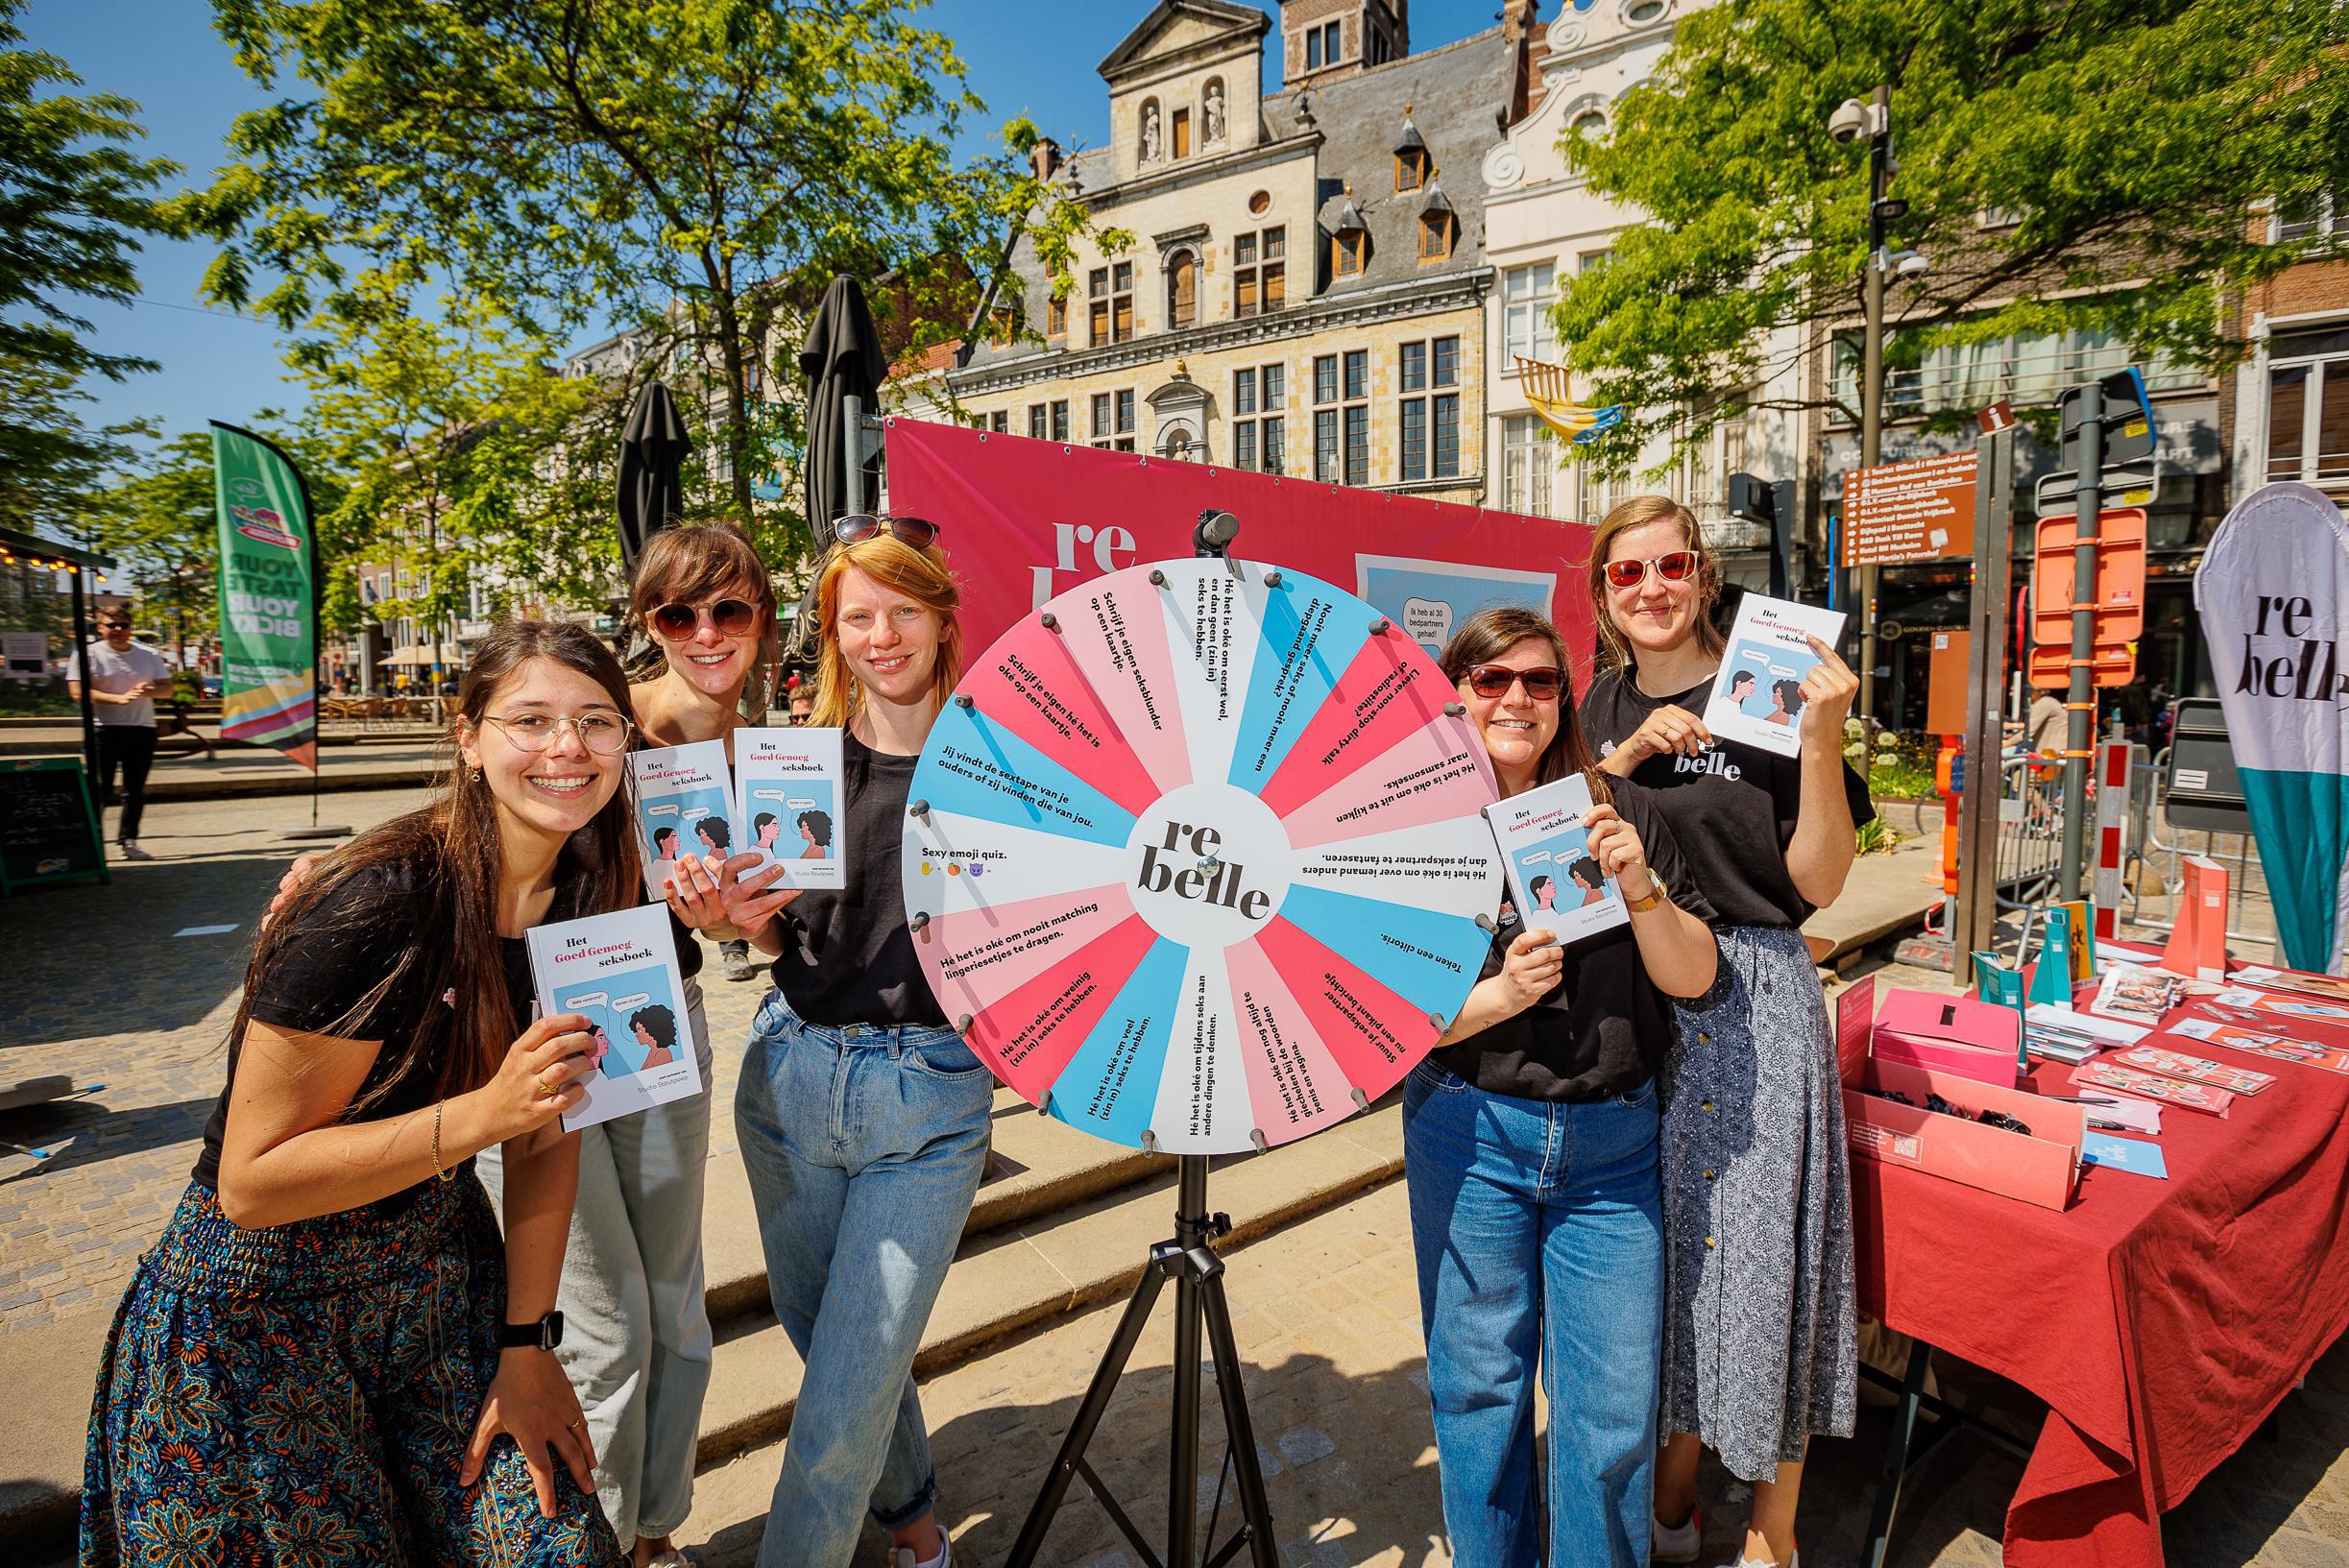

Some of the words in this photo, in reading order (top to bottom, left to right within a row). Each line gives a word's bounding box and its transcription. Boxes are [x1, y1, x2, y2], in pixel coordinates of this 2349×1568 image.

[1053, 522, 1136, 573] re
[1314, 603, 1333, 633] Nooit
[1417, 608, 1428, 616] heb
[1436, 609, 1443, 617] 30
[1750, 616, 1773, 627] Goed
[1762, 609, 1778, 618] Het
[2254, 595, 2313, 638] re
[1292, 597, 1320, 651] diepgaand
[1409, 618, 1444, 628] bedpartners
[1091, 597, 1101, 612] op
[1097, 613, 1109, 632] een
[1104, 632, 1125, 673] kaartje.
[1417, 630, 1437, 639] gehad!
[1303, 633, 1319, 661] meer
[1102, 591, 1125, 626] Schrijf
[1114, 626, 1126, 639] je
[1122, 639, 1137, 668] eigen
[1132, 668, 1162, 731] seksblunder
[1397, 662, 1408, 675] of
[1273, 650, 1296, 698] gesprek?
[1292, 660, 1306, 685] seks
[1393, 668, 1420, 694] Liever
[1007, 654, 1038, 683] Schrijf
[1031, 680, 1044, 692] je
[1043, 691, 1067, 715] eigen
[1065, 711, 1078, 726] hé
[1077, 722, 1093, 740] het
[1090, 736, 1101, 748] is
[1287, 685, 1296, 698] of
[1354, 670, 1399, 717] radiostilte?
[998, 665, 1016, 682] oké
[1014, 681, 1027, 693] op
[1026, 692, 1042, 709] een
[1040, 705, 1071, 740] kaartje.
[1274, 697, 1291, 725] nooit
[1358, 692, 1394, 729] non-stop
[761, 742, 776, 752] Het
[1264, 726, 1279, 753] meer
[1338, 728, 1359, 749] dirty
[647, 762, 664, 771] Het
[750, 753, 774, 761] Goed
[1254, 753, 1267, 772] een
[1321, 748, 1341, 765] talk
[1674, 752, 1741, 781] belle
[640, 771, 663, 782] Goed
[782, 763, 824, 772] seksboek
[942, 745, 956, 759] Jij
[957, 752, 983, 769] vindt
[983, 762, 997, 775] de
[998, 770, 1038, 791] sextape
[1040, 786, 1058, 799] van
[1056, 792, 1069, 804] je
[671, 774, 713, 786] seksboek
[938, 760, 974, 779] ouders
[975, 774, 988, 784] of
[987, 779, 1002, 791] zij
[1002, 784, 1036, 804] vinden
[1037, 798, 1053, 811] die
[1055, 807, 1073, 819] van
[1072, 812, 1093, 828] jou.
[1514, 809, 1531, 819] Het
[1540, 812, 1580, 832] seksboek
[1509, 818, 1532, 832] Goed
[1161, 820, 1222, 857] re
[922, 847, 948, 859] Sexy
[949, 849, 979, 860] emoji
[981, 849, 1007, 861] quiz.
[1137, 844, 1270, 920] belle
[567, 936, 588, 948] Het
[939, 955, 956, 969] Hé
[955, 950, 974, 962] het
[974, 947, 984, 955] is
[985, 937, 1005, 952] oké
[1005, 932, 1022, 944] om
[1022, 921, 1051, 937] nooit
[1051, 903, 1099, 926] matching
[1380, 933, 1416, 953] clitoris.
[554, 948, 586, 964] Goed
[598, 948, 653, 968] seksboek
[944, 950, 1012, 980] lingeriesetjes
[1012, 945, 1025, 953] te
[1026, 931, 1064, 949] dragen.
[1417, 948, 1434, 959] een
[1435, 955, 1462, 974] Teken
[1324, 973, 1359, 1009] berichtje
[1323, 991, 1369, 1034] sekspartner
[1356, 1004, 1384, 1030] pikant
[1368, 1032, 1379, 1044] je
[1380, 1028, 1395, 1043] een
[1374, 1041, 1397, 1064] Stuur
[1394, 1042, 1406, 1053] nu
[638, 1082, 659, 1094] Studio
